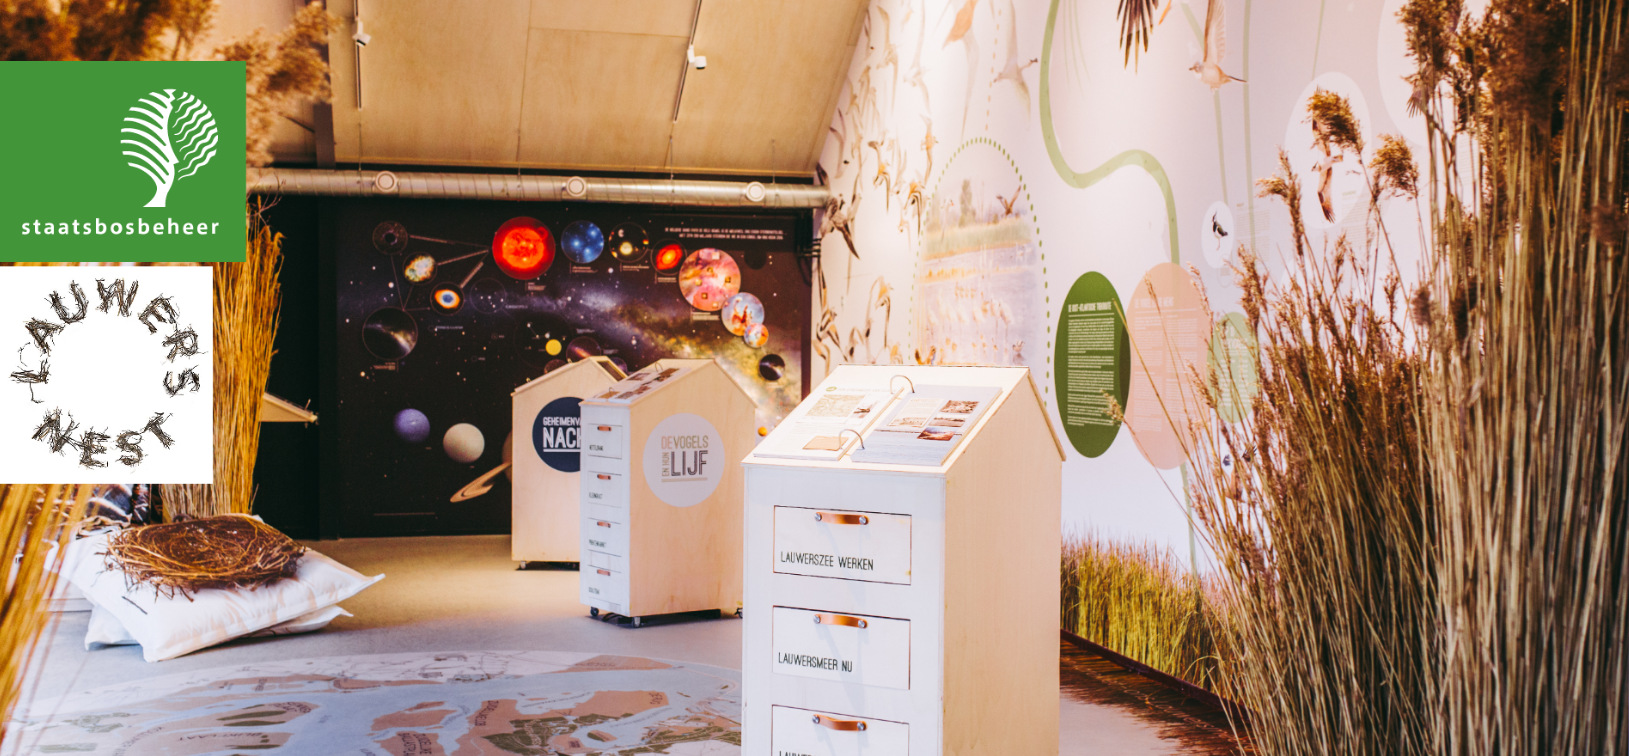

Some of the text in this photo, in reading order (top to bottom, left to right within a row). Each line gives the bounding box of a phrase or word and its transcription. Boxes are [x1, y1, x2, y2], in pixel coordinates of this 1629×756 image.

[661, 451, 670, 477] EN HUN
[671, 450, 709, 477] LIJF
[780, 551, 874, 571] LAUWERSZEE WERKEN
[778, 652, 853, 673] LAUWERSMEER NU
